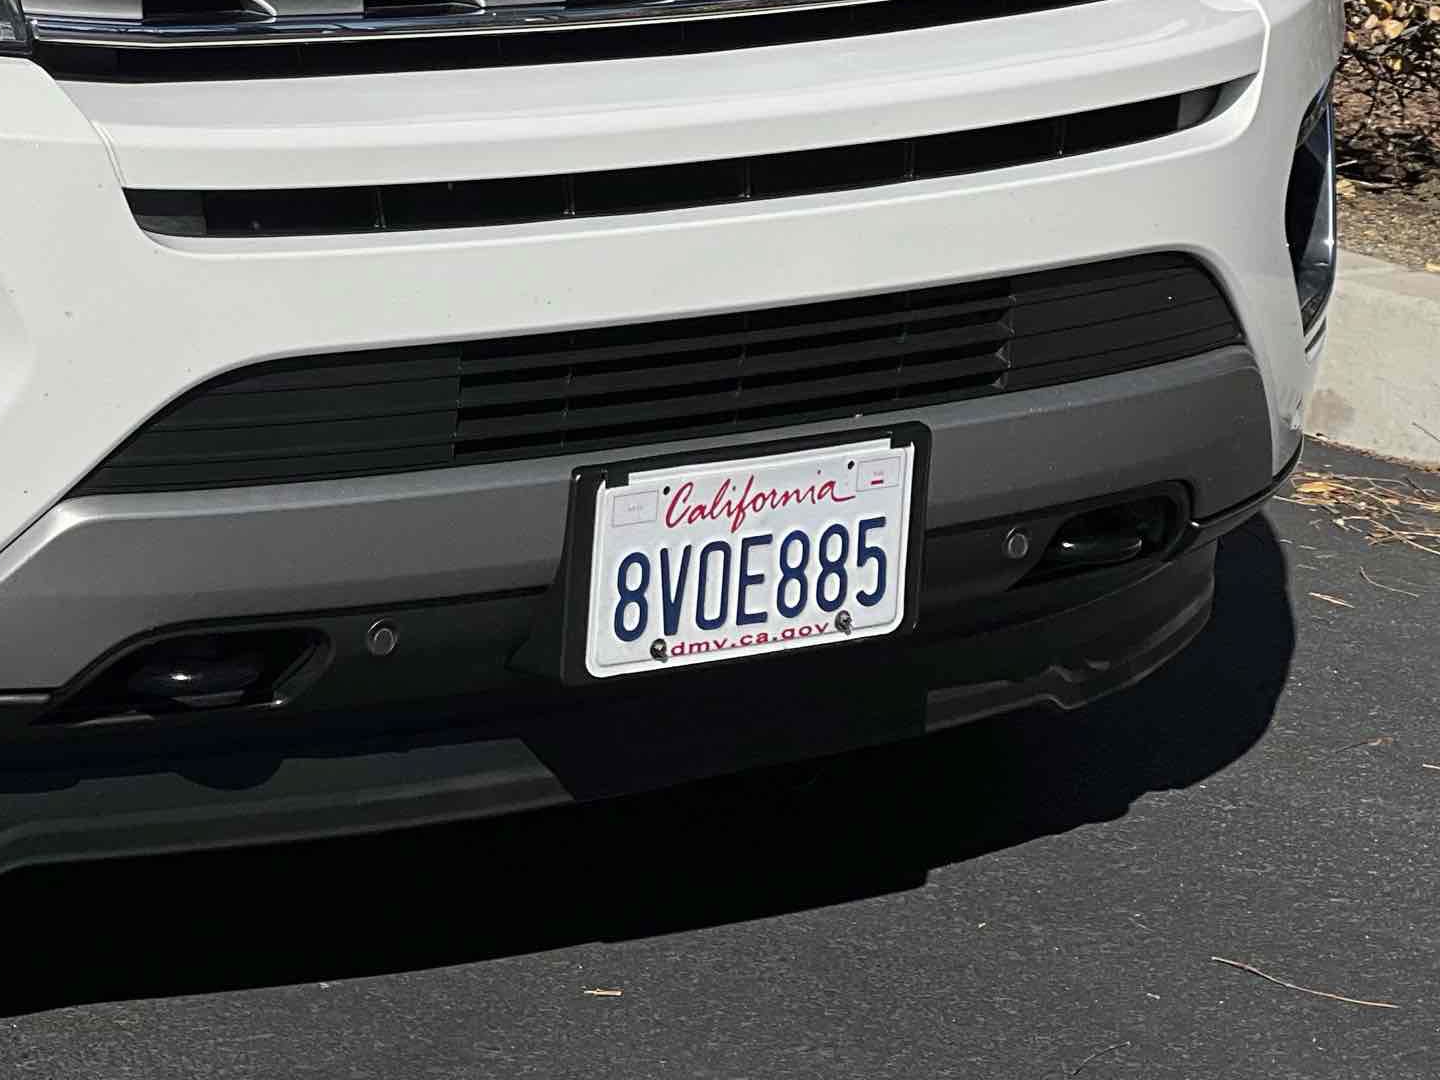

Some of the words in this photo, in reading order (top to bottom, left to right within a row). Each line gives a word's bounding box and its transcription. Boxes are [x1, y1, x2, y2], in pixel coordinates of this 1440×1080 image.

[665, 474, 857, 534] California
[613, 516, 888, 643] 8VOE885
[670, 622, 830, 658] dmv.ca.gov
